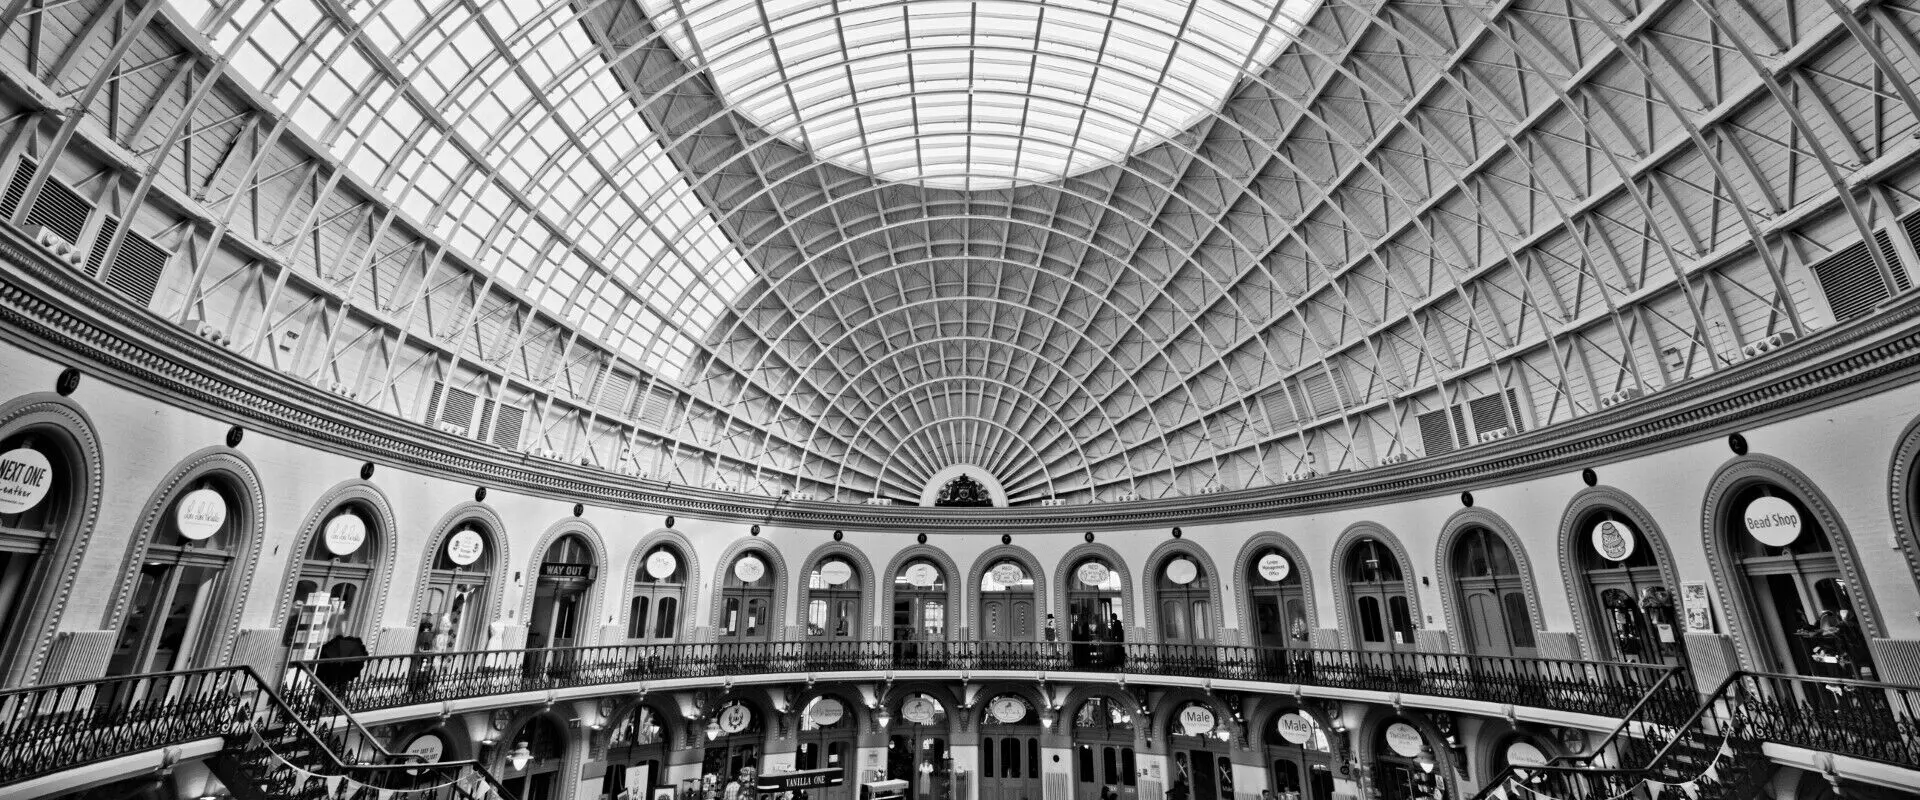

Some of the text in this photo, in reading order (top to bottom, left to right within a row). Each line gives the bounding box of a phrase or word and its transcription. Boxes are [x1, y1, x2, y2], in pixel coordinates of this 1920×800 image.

[0, 459, 47, 488] NEXT ONE
[1747, 512, 1797, 529] Bead Shop
[546, 565, 583, 575] WAY OUT
[785, 775, 826, 787] VANILLA ONE
